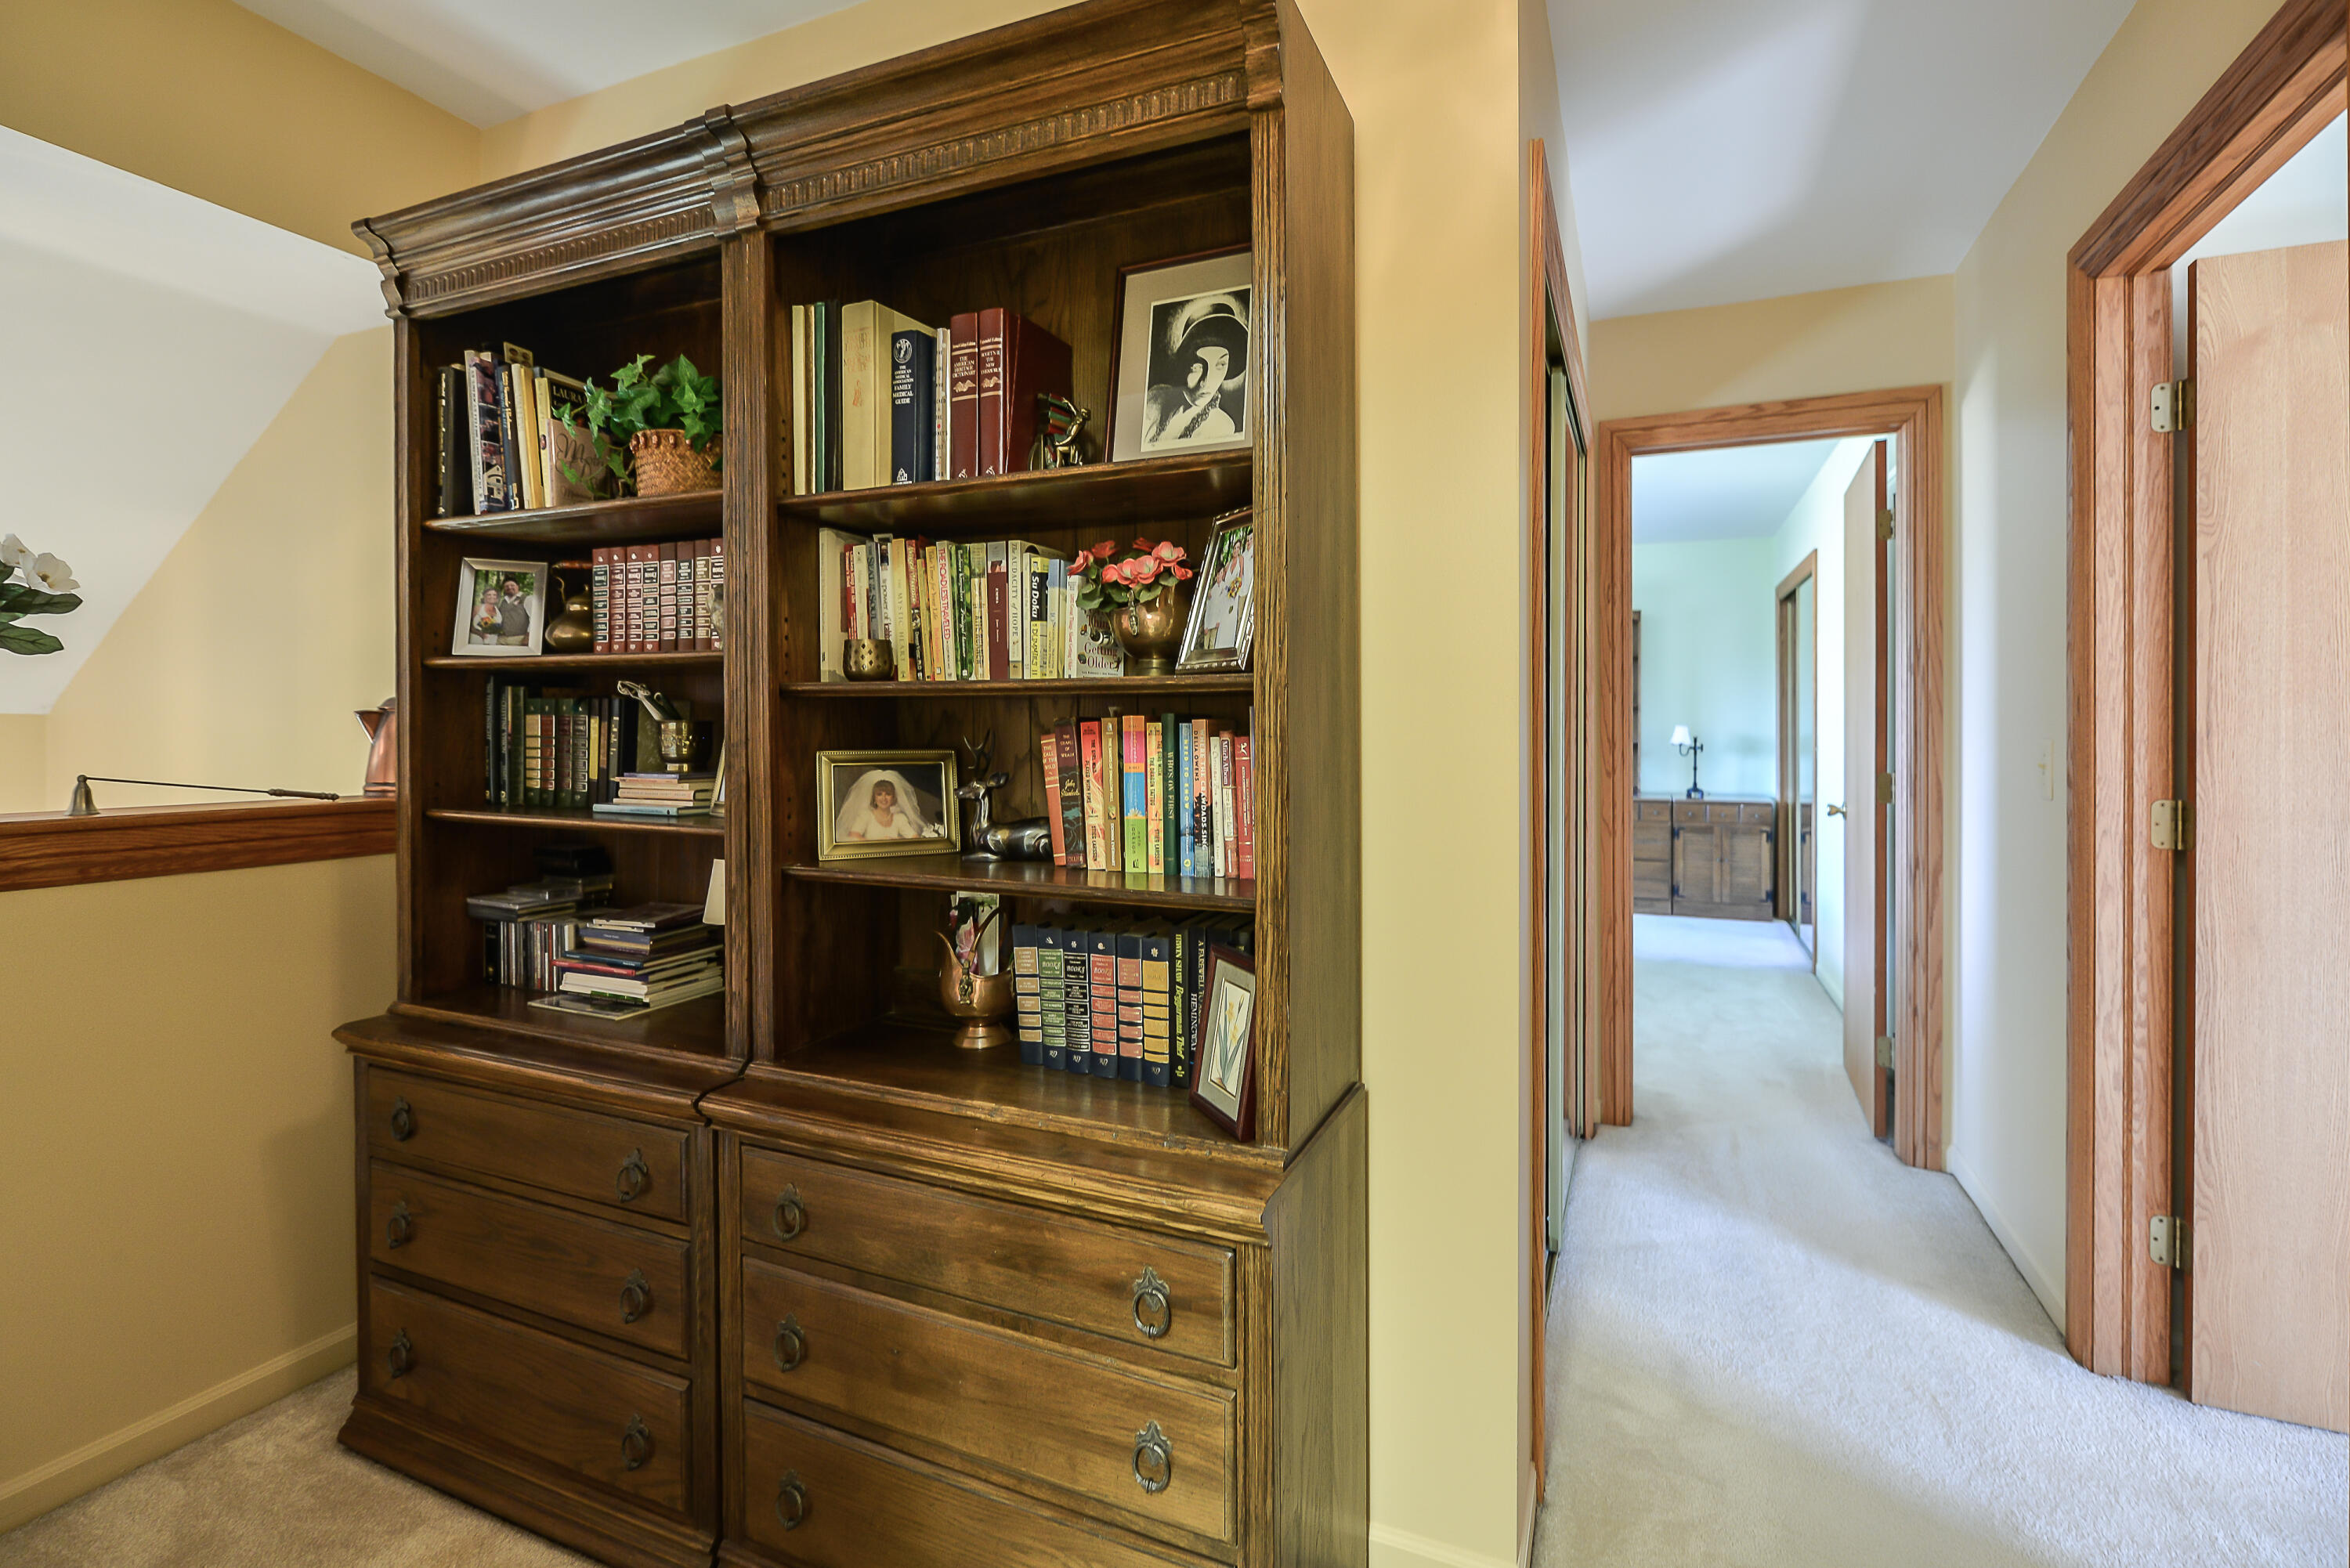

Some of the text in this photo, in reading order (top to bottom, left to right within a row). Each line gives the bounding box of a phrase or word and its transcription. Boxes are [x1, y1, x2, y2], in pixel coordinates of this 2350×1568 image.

[553, 385, 582, 404] LAURA
[867, 557, 876, 582] SEAT
[1032, 576, 1039, 589] Su
[869, 595, 877, 622] SOUL
[884, 612, 891, 620] of
[942, 602, 951, 640] TRAVELED
[1084, 642, 1118, 658] Getting
[1087, 656, 1114, 669] Older
[1184, 767, 1189, 777] TO
[1168, 780, 1173, 791] ON
[1067, 965, 1085, 974] BOOKS
[1094, 966, 1112, 976] BOOKS
